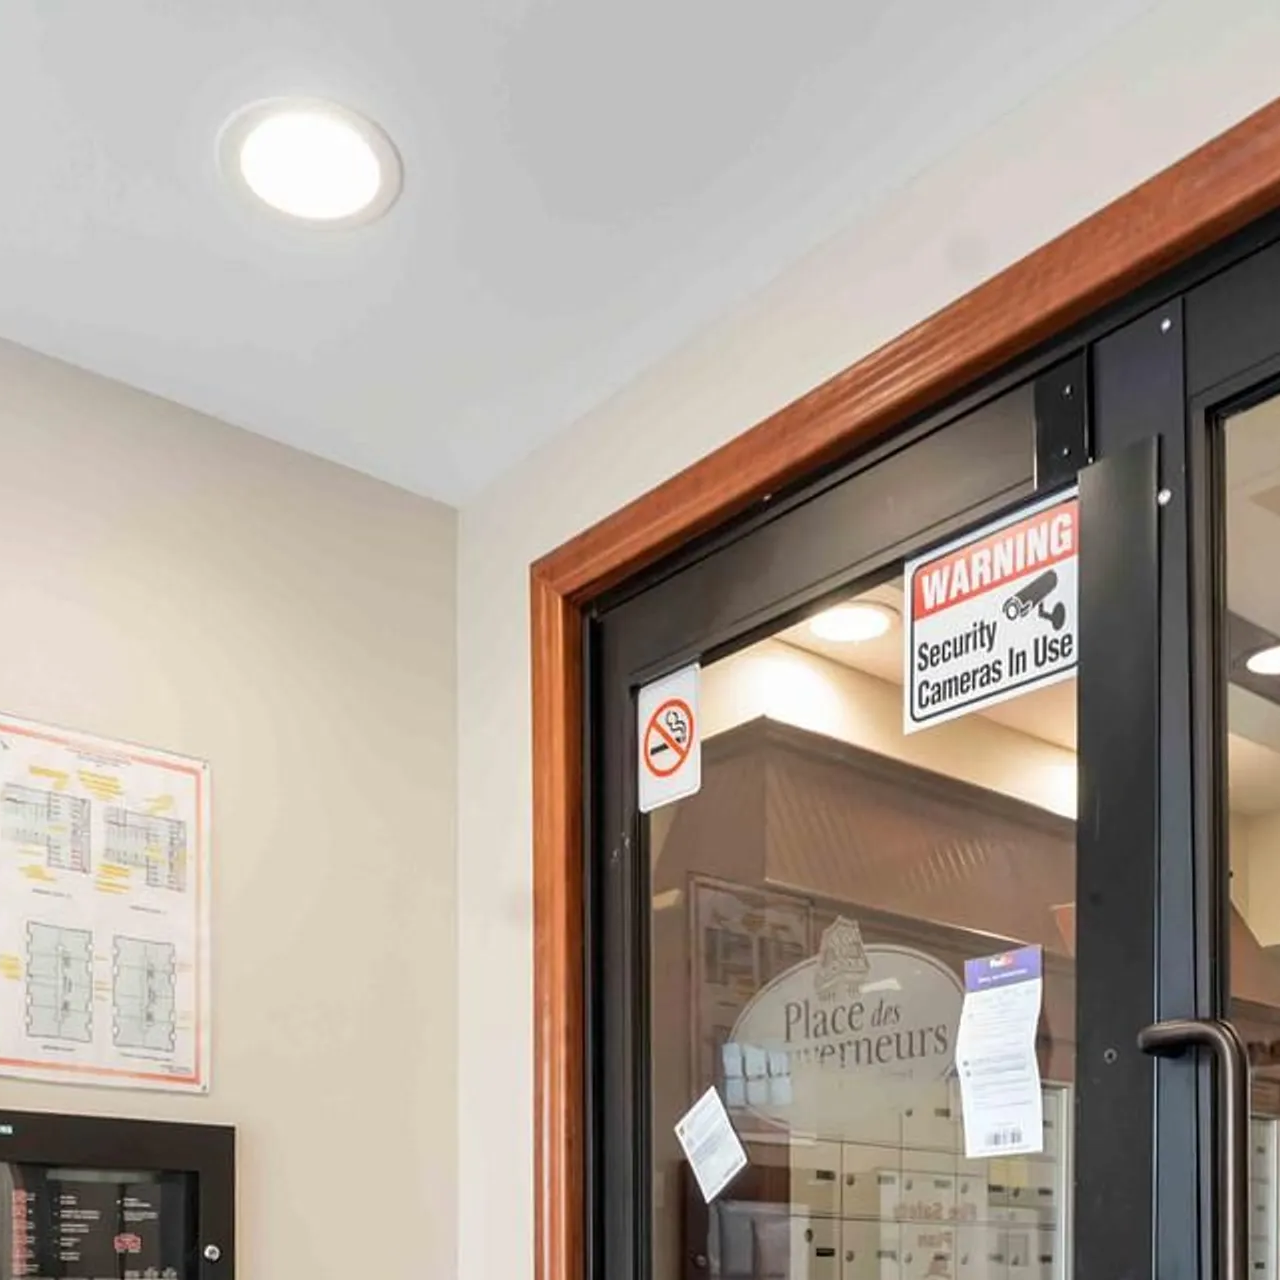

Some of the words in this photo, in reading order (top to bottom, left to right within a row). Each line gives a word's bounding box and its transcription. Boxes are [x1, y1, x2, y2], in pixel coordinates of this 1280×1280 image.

[921, 512, 1073, 610] WARNING
[917, 620, 998, 672] Security
[918, 657, 1003, 709] Cameras
[1008, 647, 1027, 678] In
[1033, 632, 1073, 668] Use
[783, 999, 865, 1043] Place
[870, 998, 901, 1027] des
